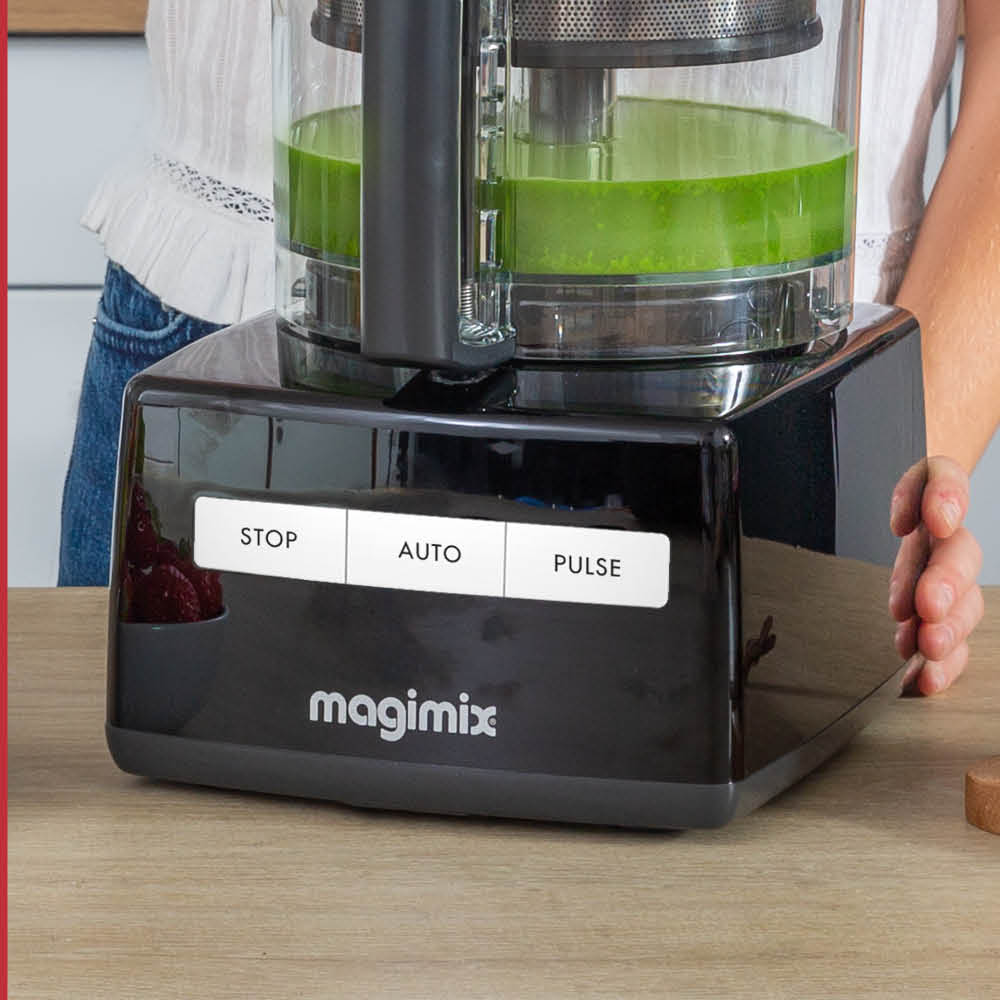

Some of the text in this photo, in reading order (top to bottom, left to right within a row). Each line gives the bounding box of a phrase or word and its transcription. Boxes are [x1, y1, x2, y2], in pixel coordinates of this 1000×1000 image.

[240, 527, 621, 578] STOP AUTO PULSE
[309, 688, 497, 742] magimix
